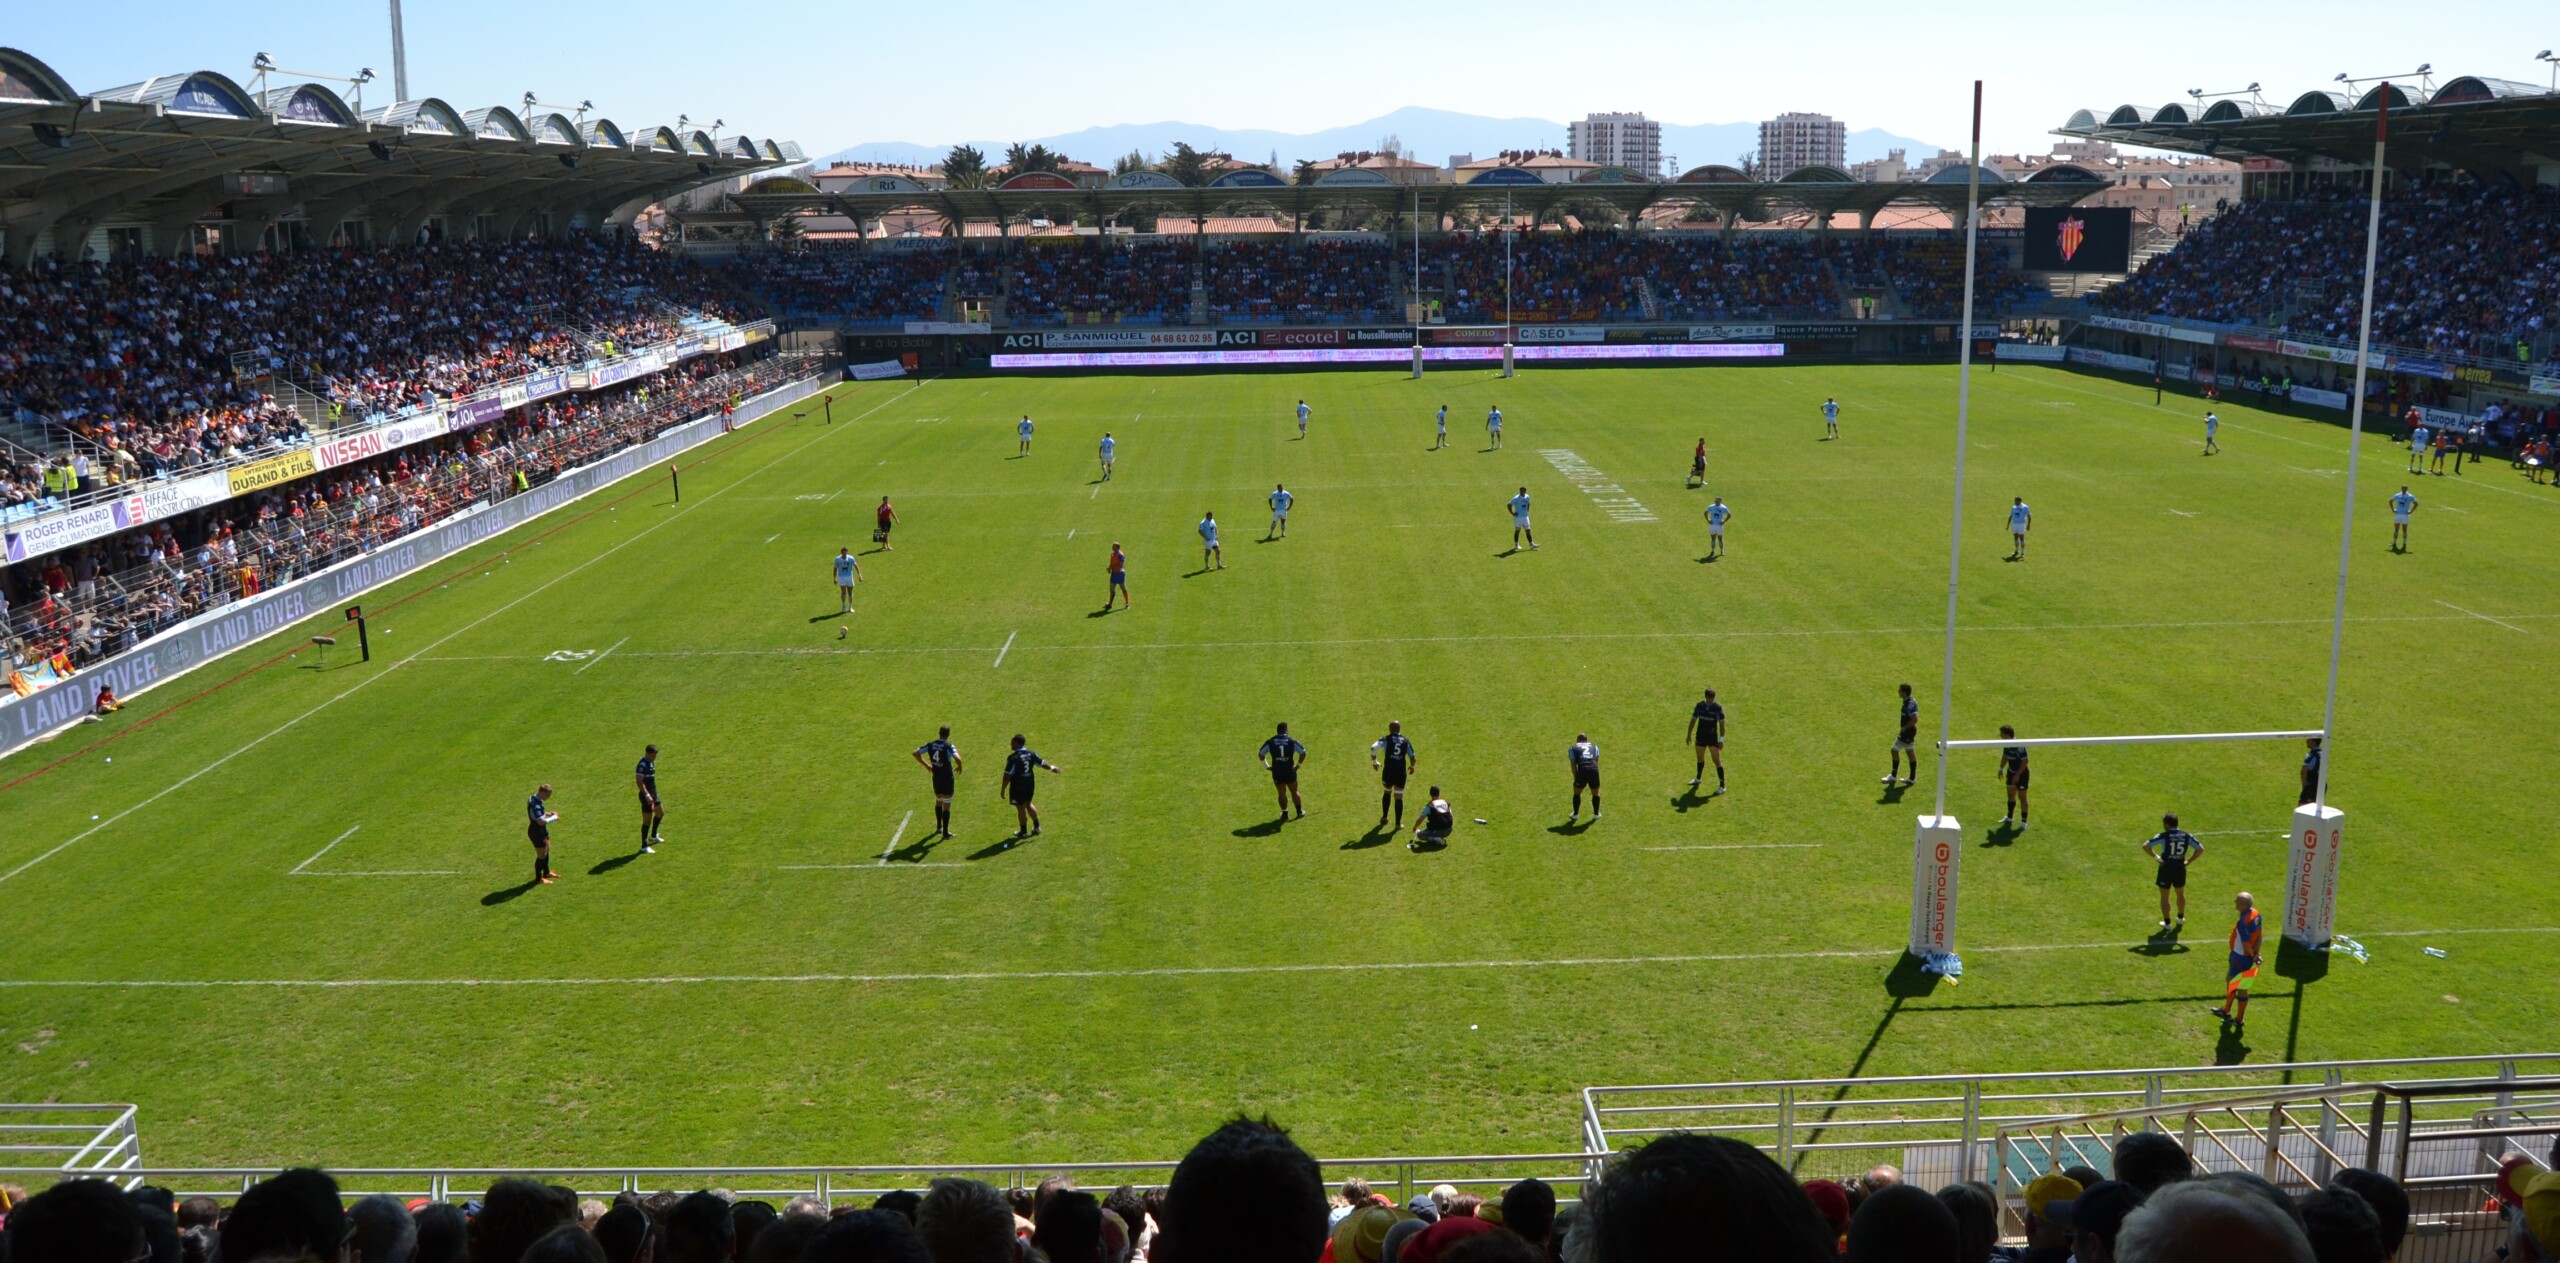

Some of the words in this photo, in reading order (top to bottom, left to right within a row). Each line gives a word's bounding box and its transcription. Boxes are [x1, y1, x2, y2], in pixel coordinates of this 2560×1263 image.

[1063, 332, 1146, 341] SANMIQUEL
[1151, 334, 1160, 343] 04
[1163, 334, 1174, 343] 68
[1176, 333, 1187, 343] 62
[1189, 333, 1200, 342] 02
[1202, 333, 1213, 342] 95
[1220, 332, 1256, 344] ACI
[1285, 330, 1340, 343] ecotel
[1347, 331, 1356, 340] La
[1357, 329, 1413, 340] Roussillonnaise
[1521, 327, 1565, 339] CASÉO
[1776, 326, 1805, 335] Square
[1004, 335, 1040, 347] ACI
[460, 408, 476, 425] JOA
[2426, 409, 2456, 428] Europe
[321, 432, 382, 468] NISSAN
[233, 470, 278, 492] DURAND
[291, 460, 313, 476] FILS
[592, 467, 611, 486] LAND
[612, 454, 634, 474] ROVER
[146, 487, 178, 508] EIFFAGE
[523, 493, 547, 516] LAND
[549, 479, 575, 503] ROVER
[148, 495, 204, 520] CONSTRUCTION
[25, 522, 65, 542] ROGER
[67, 508, 109, 529] RENARD
[441, 522, 469, 551] LAND
[472, 509, 504, 537] ROVER
[29, 538, 57, 554] GENIE
[59, 522, 112, 545] CLIMATIQUE
[336, 563, 371, 597] LAND
[374, 544, 416, 578] ROVER
[201, 616, 248, 656] LAND
[252, 591, 304, 634] ROVER
[20, 684, 83, 736] LAND
[89, 652, 159, 707] ROVER
[933, 750, 940, 763] 4
[1278, 745, 1285, 758] 1
[1393, 743, 1400, 755] 5
[1582, 746, 1590, 755] 2
[1023, 760, 1030, 773] 3
[2169, 841, 2185, 855] 15
[2295, 851, 2315, 933] boulanger
[1932, 865, 1949, 948] boulanger
